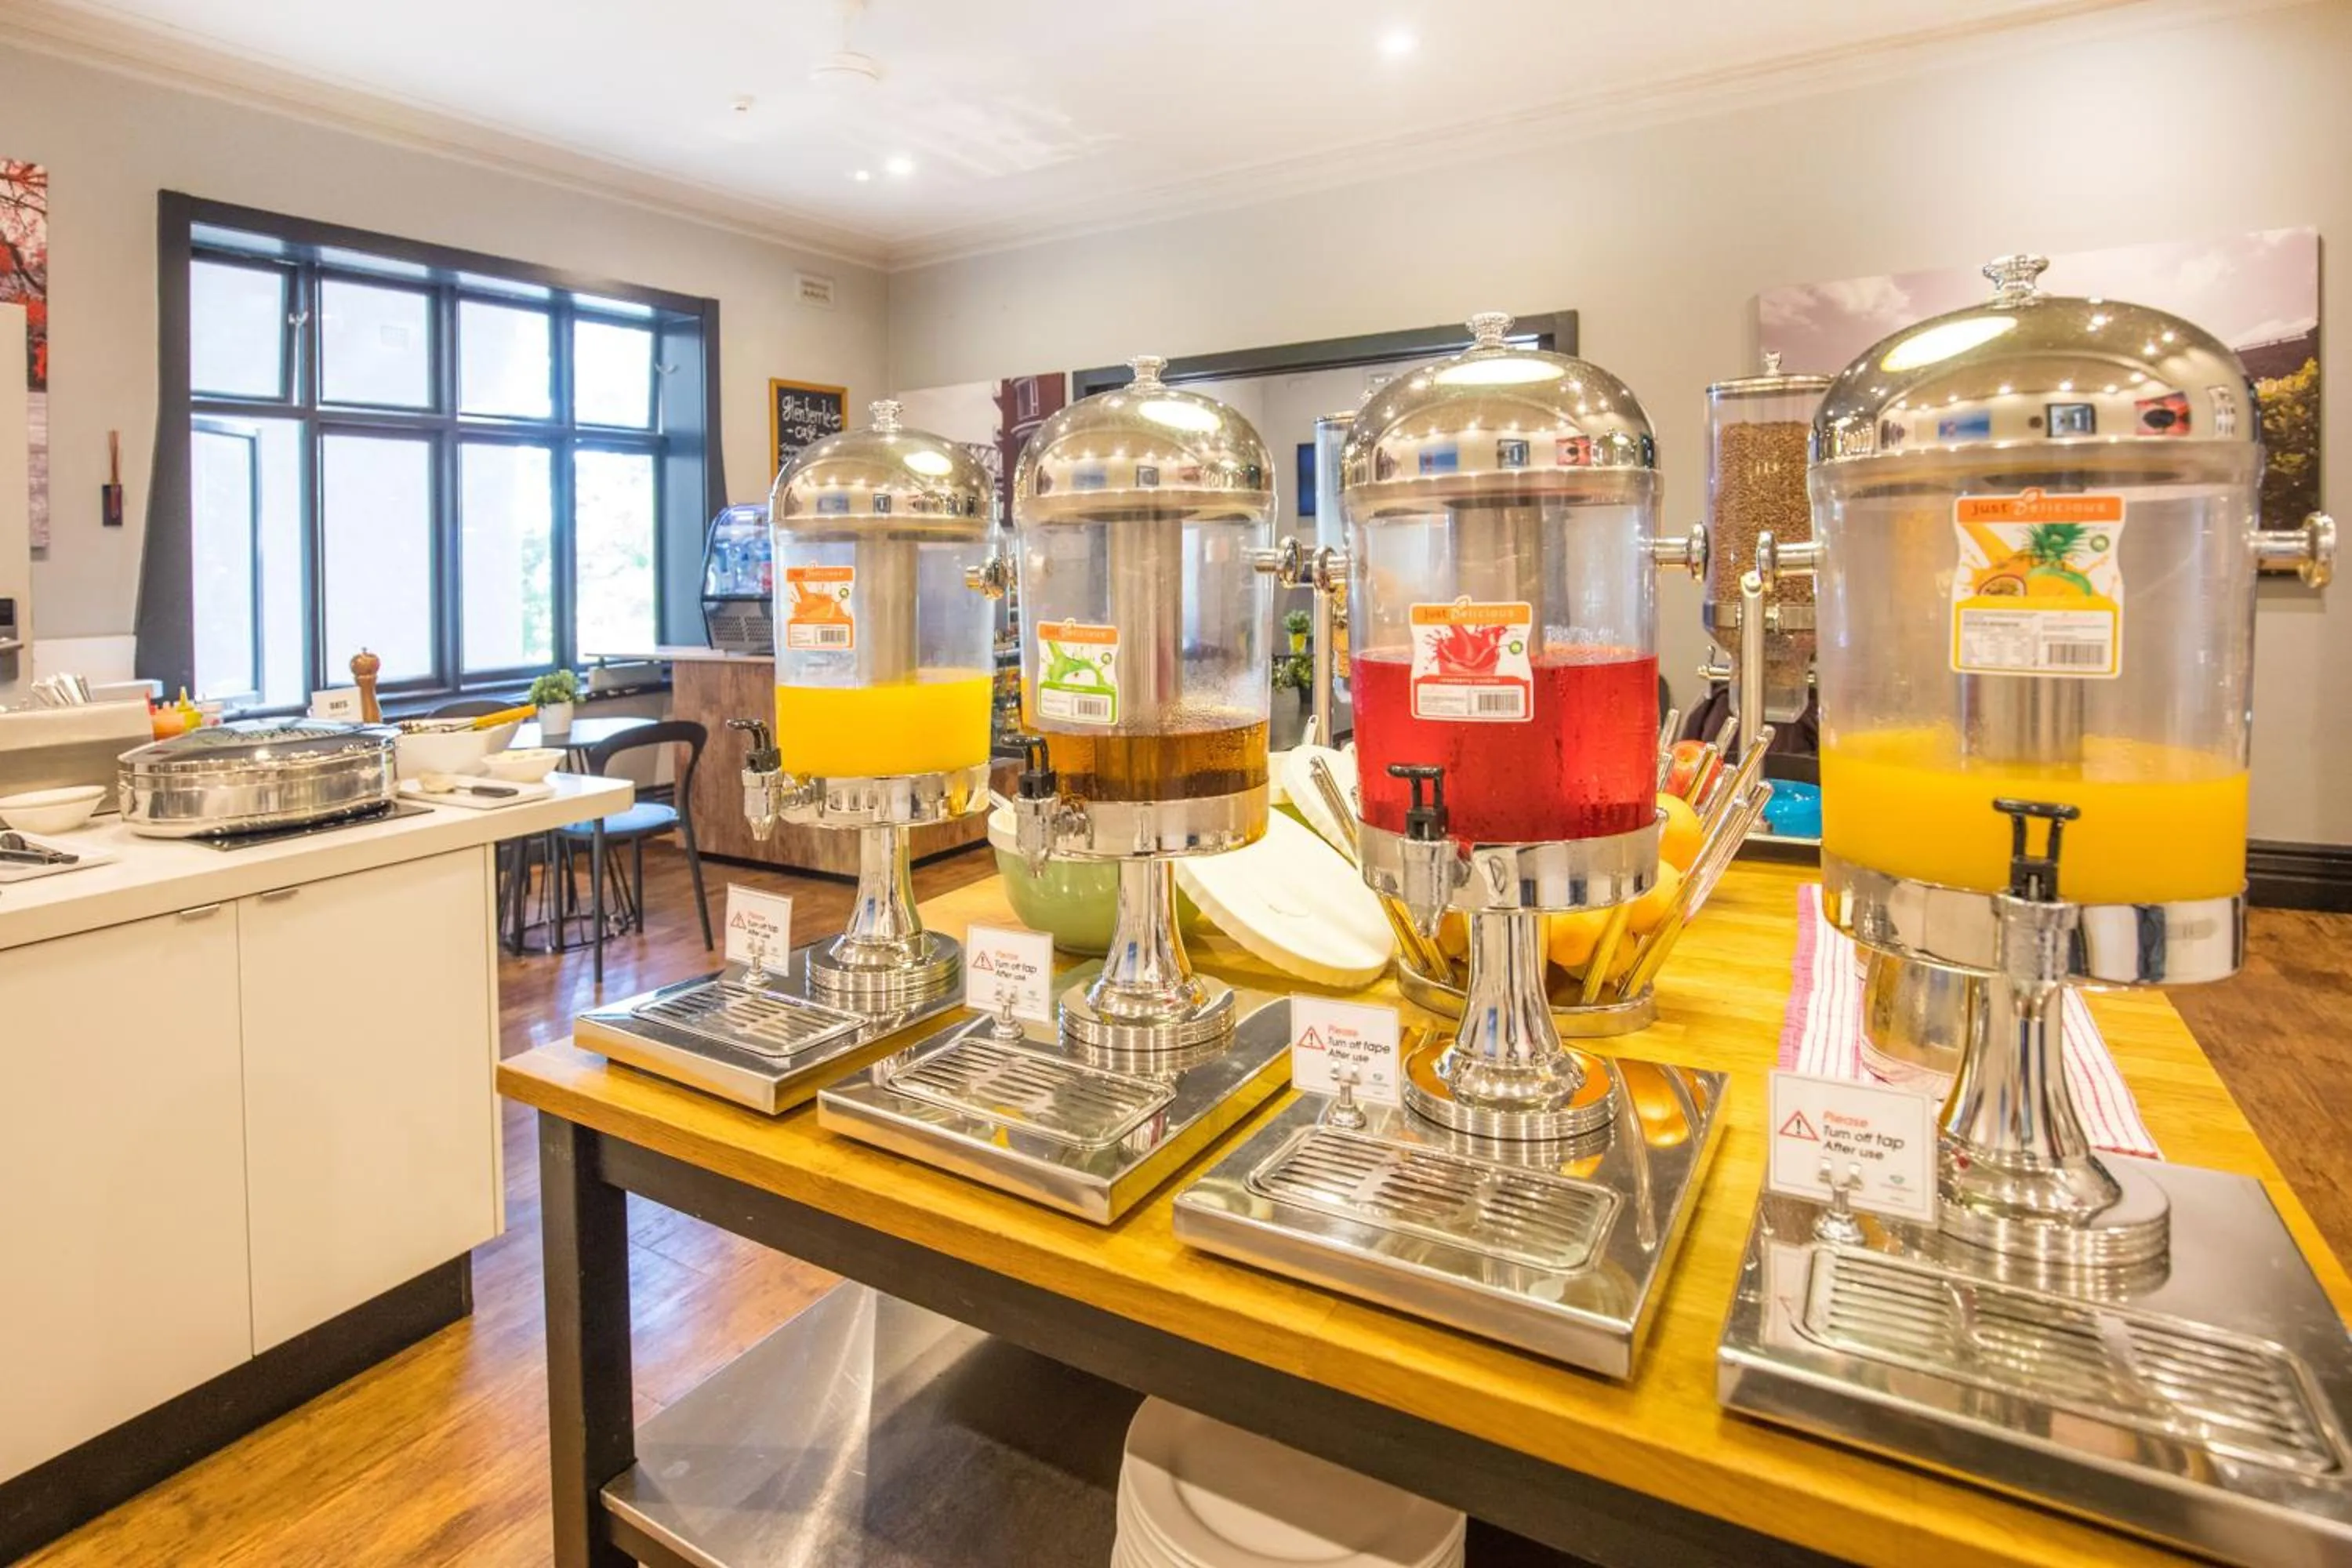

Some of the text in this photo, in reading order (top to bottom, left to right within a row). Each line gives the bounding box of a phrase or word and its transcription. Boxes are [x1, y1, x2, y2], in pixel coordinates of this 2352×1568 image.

[1327, 1036, 1347, 1047] Turn
[1363, 1040, 1391, 1054] tape
[1328, 1048, 1350, 1059] After
[1824, 1110, 1869, 1127] Please
[1823, 1124, 1905, 1152] Turn off tap
[1824, 1140, 1884, 1160] After use
